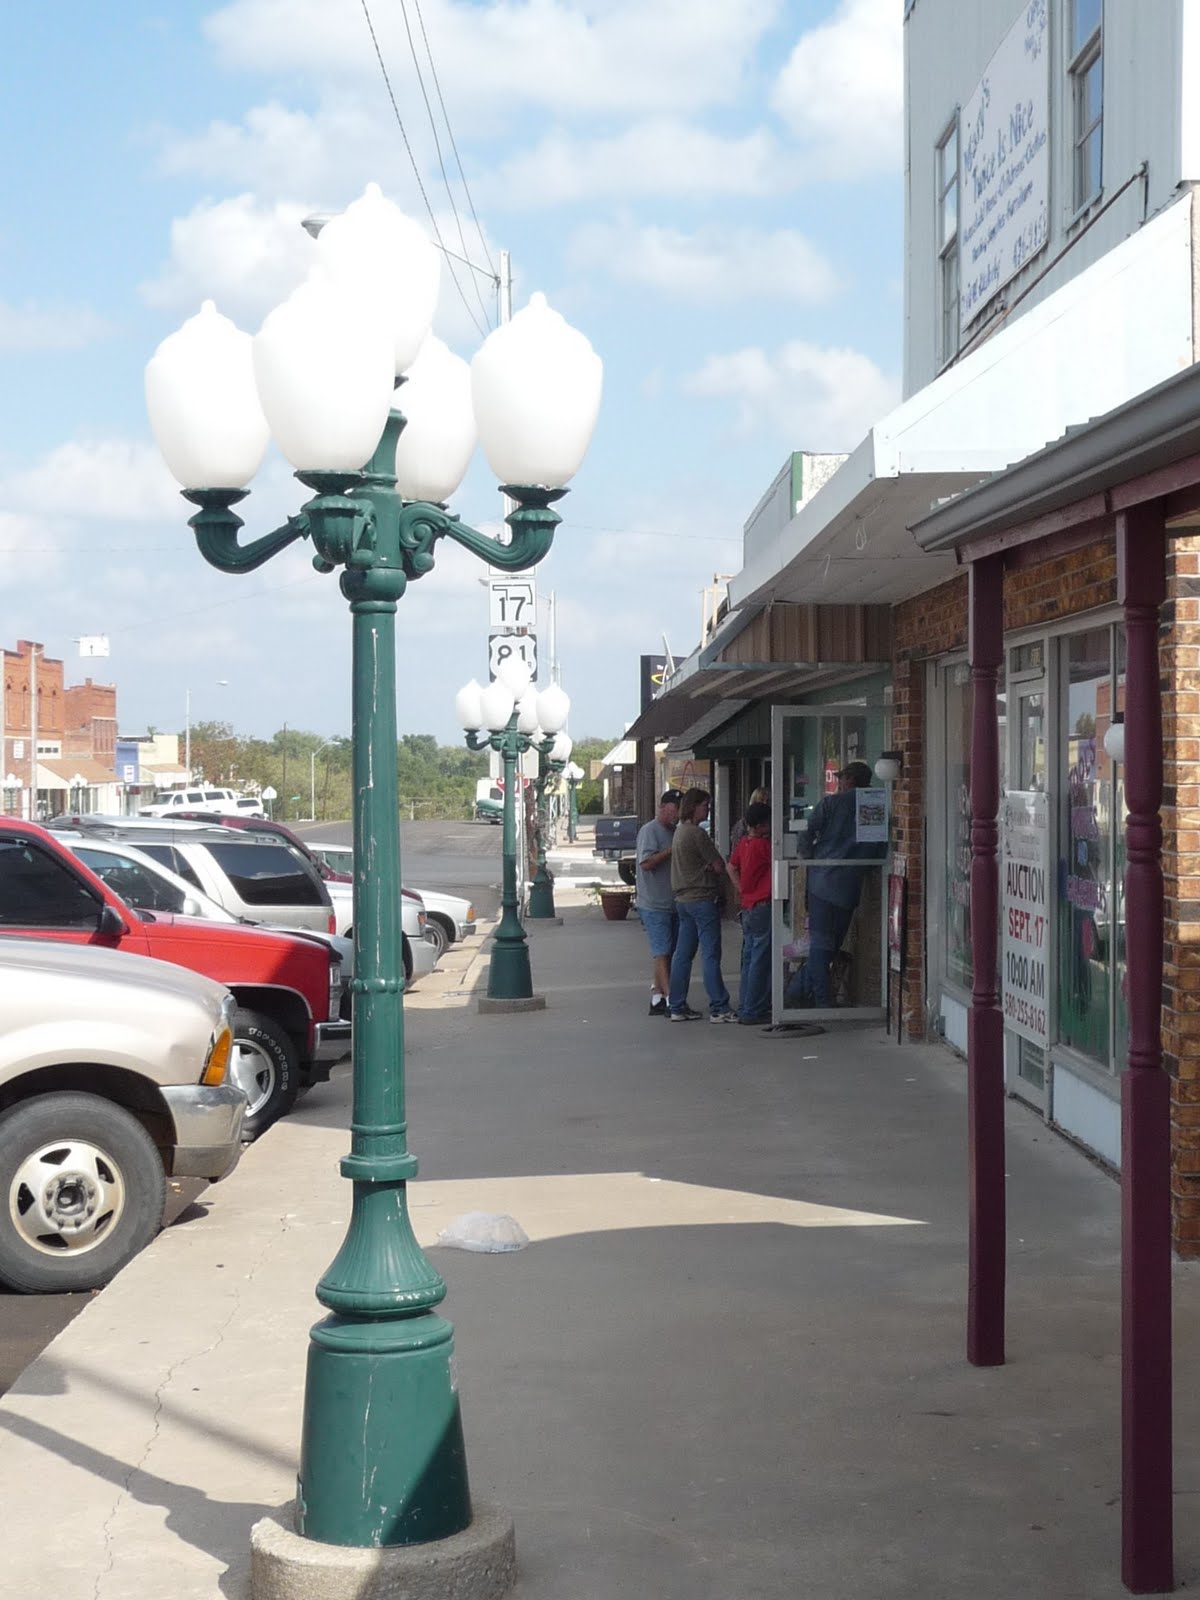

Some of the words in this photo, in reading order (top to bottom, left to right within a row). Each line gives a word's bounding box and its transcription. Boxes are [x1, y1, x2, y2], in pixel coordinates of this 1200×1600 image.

[1008, 99, 1034, 154] Nice
[498, 596, 526, 622] 17
[1006, 864, 1045, 905] AUCTION
[1008, 910, 1032, 945] SEPT.
[1034, 916, 1044, 949] 17
[1005, 950, 1028, 991] 10:00
[1029, 962, 1045, 1000] AM
[1004, 991, 1046, 1037] 580-255-8162
